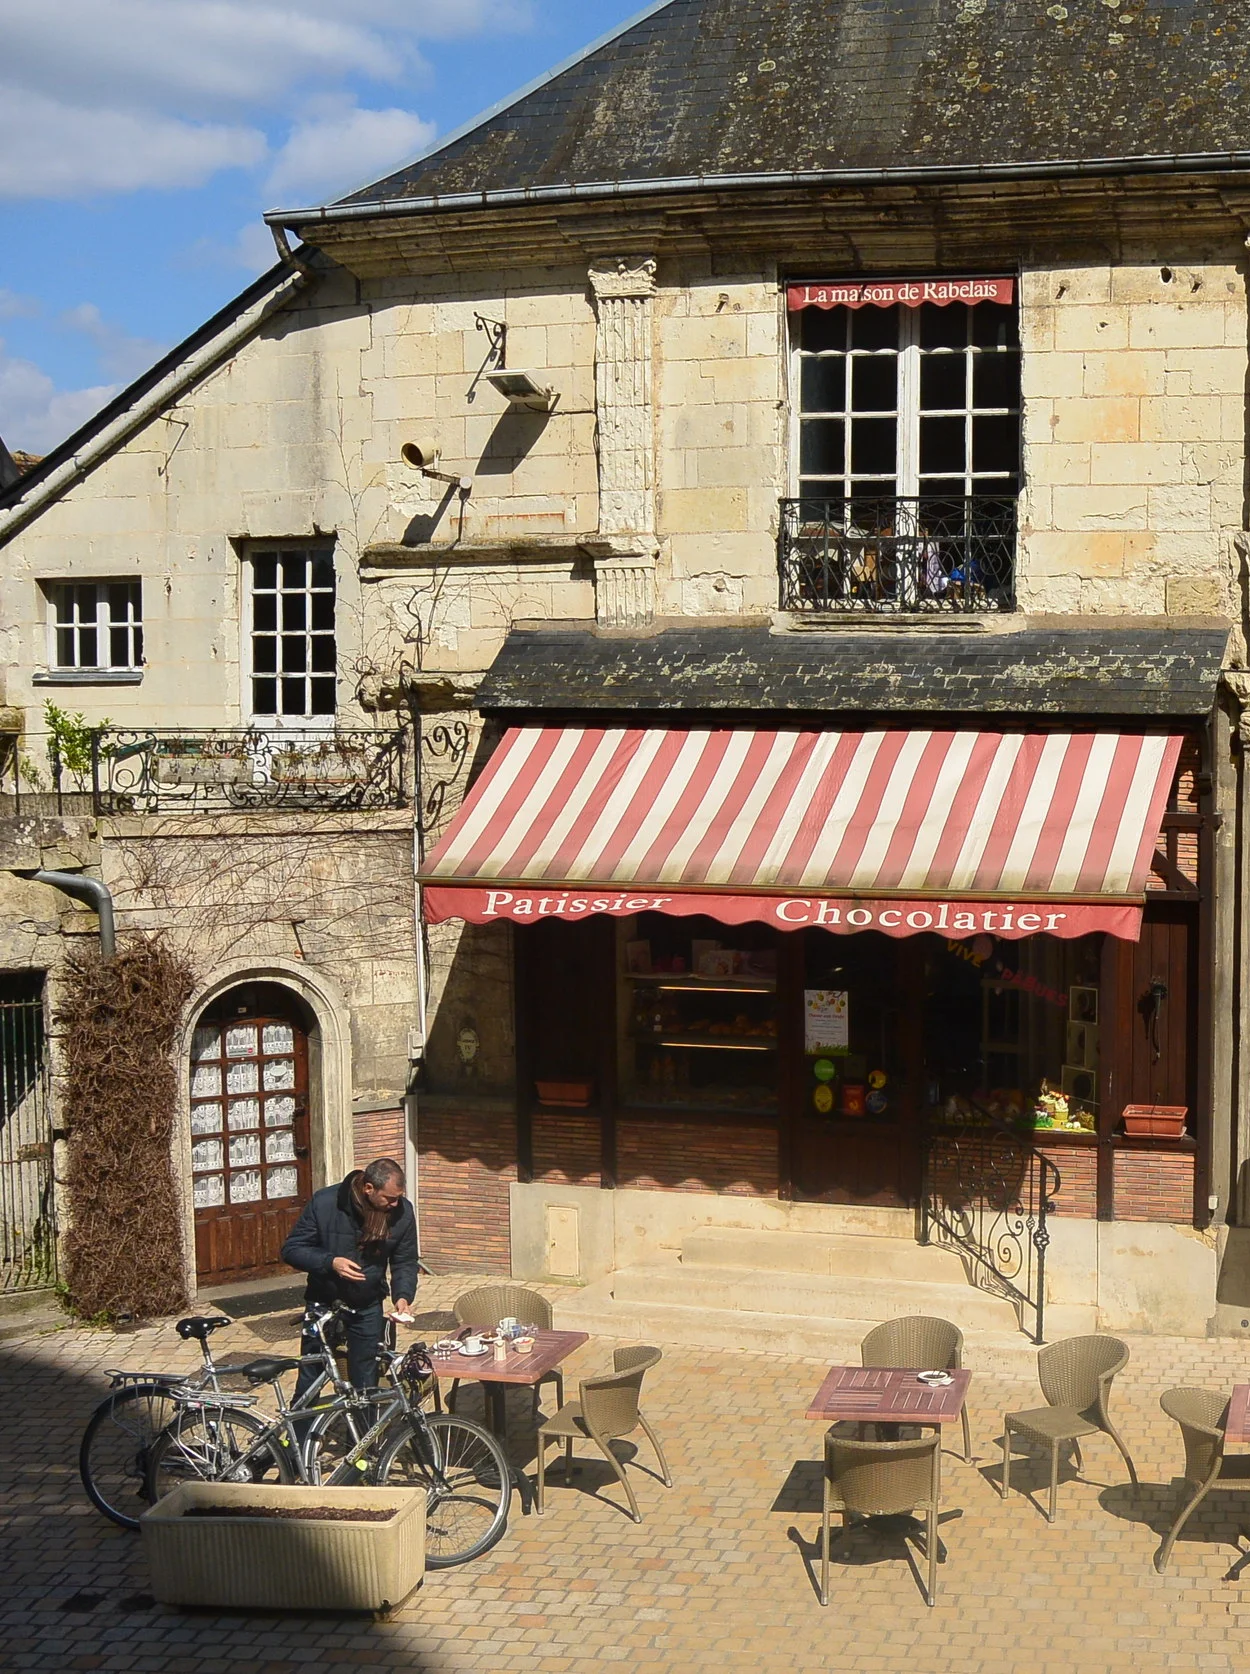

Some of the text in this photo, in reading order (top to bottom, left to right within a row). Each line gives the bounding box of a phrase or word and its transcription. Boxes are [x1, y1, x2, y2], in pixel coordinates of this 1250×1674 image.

[802, 280, 998, 303] La maison de Rabelais
[481, 890, 1067, 931] Patissier Chocolatier
